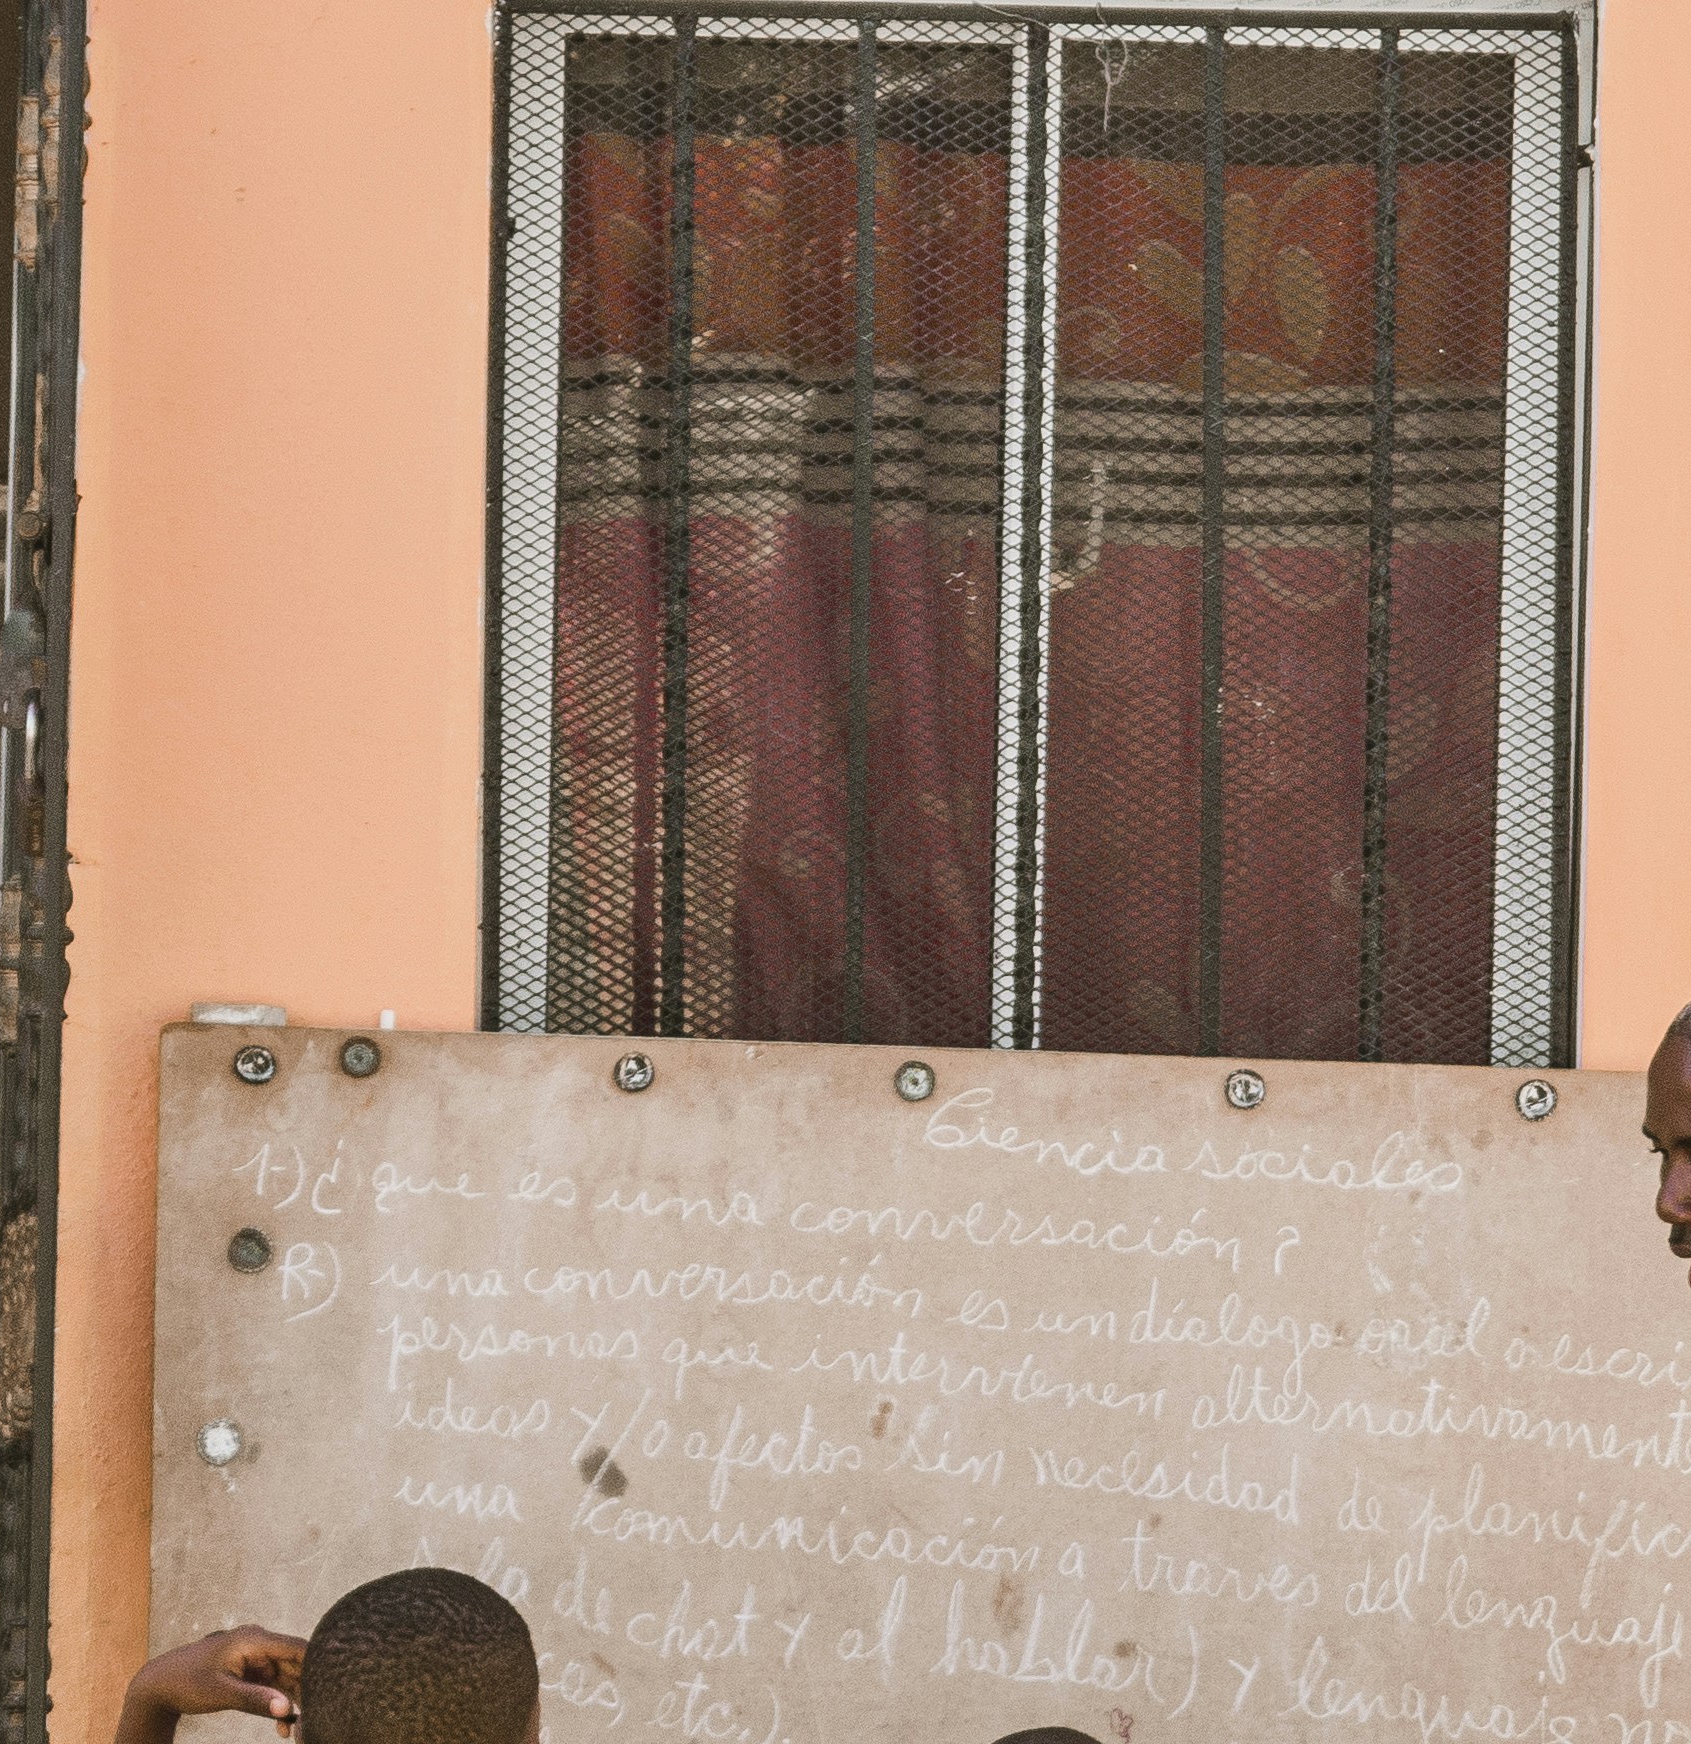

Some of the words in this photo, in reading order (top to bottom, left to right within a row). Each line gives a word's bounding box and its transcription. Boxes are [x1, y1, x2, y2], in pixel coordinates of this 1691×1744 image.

[923, 1086, 1167, 1178] Ciencia
[1186, 1128, 1465, 1195] sociales
[510, 1168, 578, 1208] es
[594, 1188, 765, 1230] una
[948, 1289, 1009, 1331] es
[378, 1312, 640, 1392] personas
[661, 1339, 773, 1398] que
[1337, 1467, 1389, 1534] de
[394, 1475, 524, 1524] una
[1058, 1539, 1087, 1579] a
[1344, 1551, 1413, 1618] del
